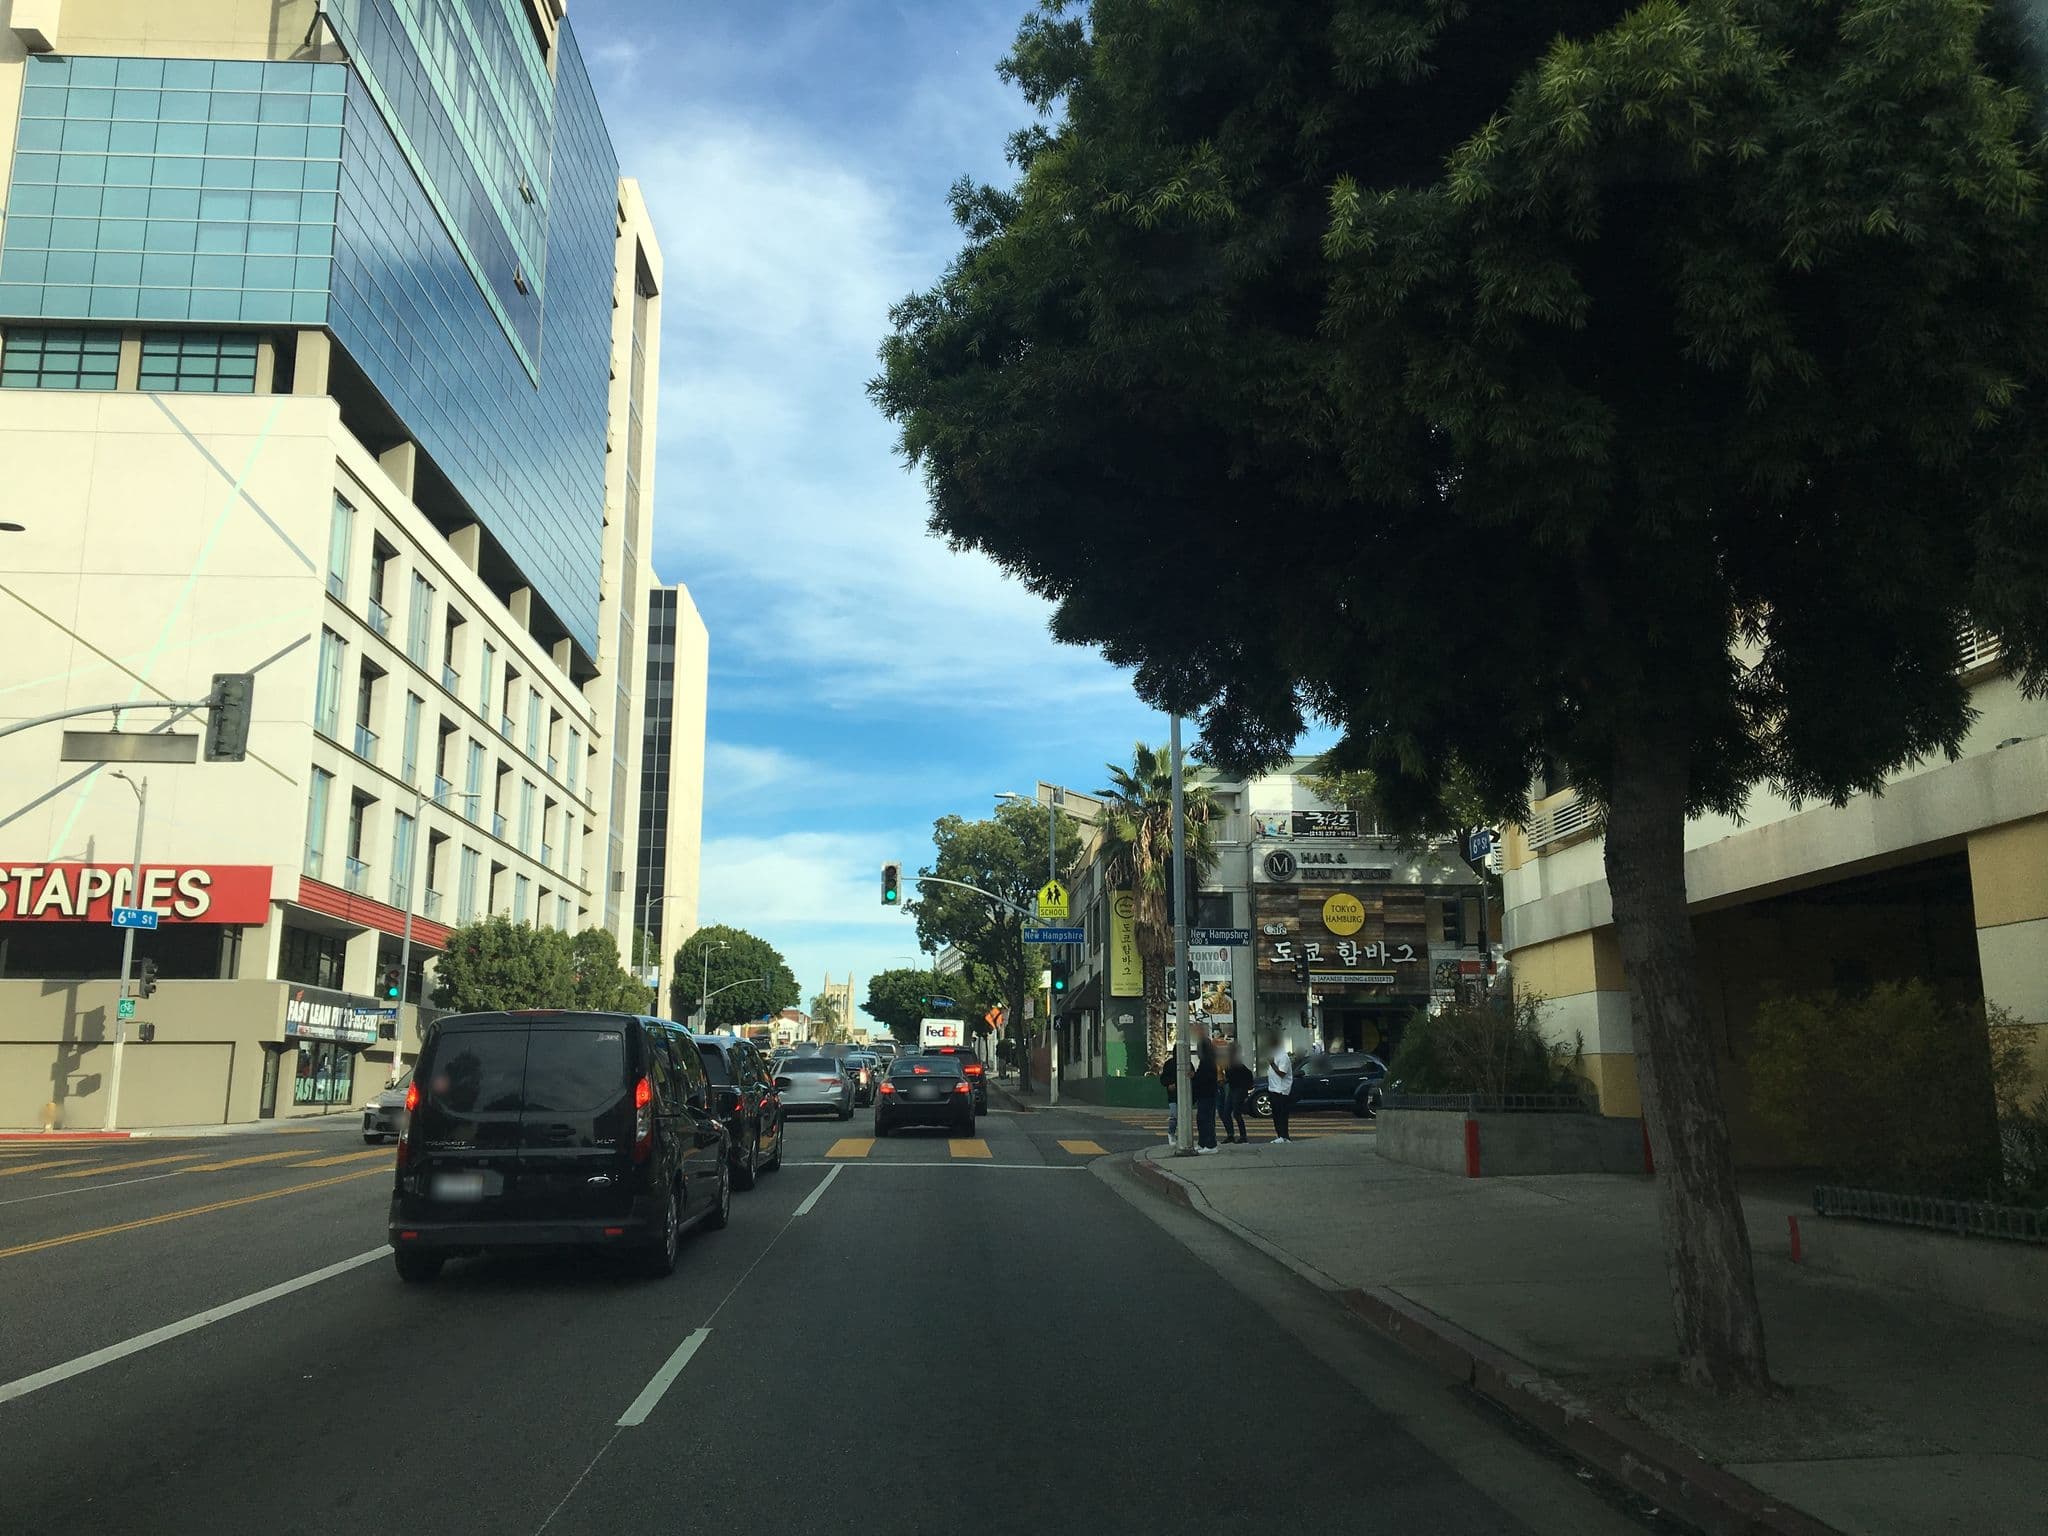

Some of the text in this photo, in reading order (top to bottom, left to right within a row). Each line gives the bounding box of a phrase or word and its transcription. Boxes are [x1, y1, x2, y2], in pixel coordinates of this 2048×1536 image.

[1300, 852, 1348, 864] HAIR &
[1272, 857, 1289, 873] M
[1301, 868, 1392, 880] BEAUTY SALON
[0, 868, 212, 917] TAPLES
[1331, 905, 1357, 913] TOKYO
[119, 911, 153, 925] 6th St
[1325, 915, 1362, 923] HAMBURG
[1190, 929, 1249, 940] New Hampshire
[1263, 923, 1287, 935] Cafe
[1024, 931, 1084, 942] New Hampshire
[1190, 952, 1219, 960] TOKYO
[287, 1000, 310, 1023] FAST
[309, 1003, 332, 1026] LEAN
[926, 1025, 958, 1038] FedEx
